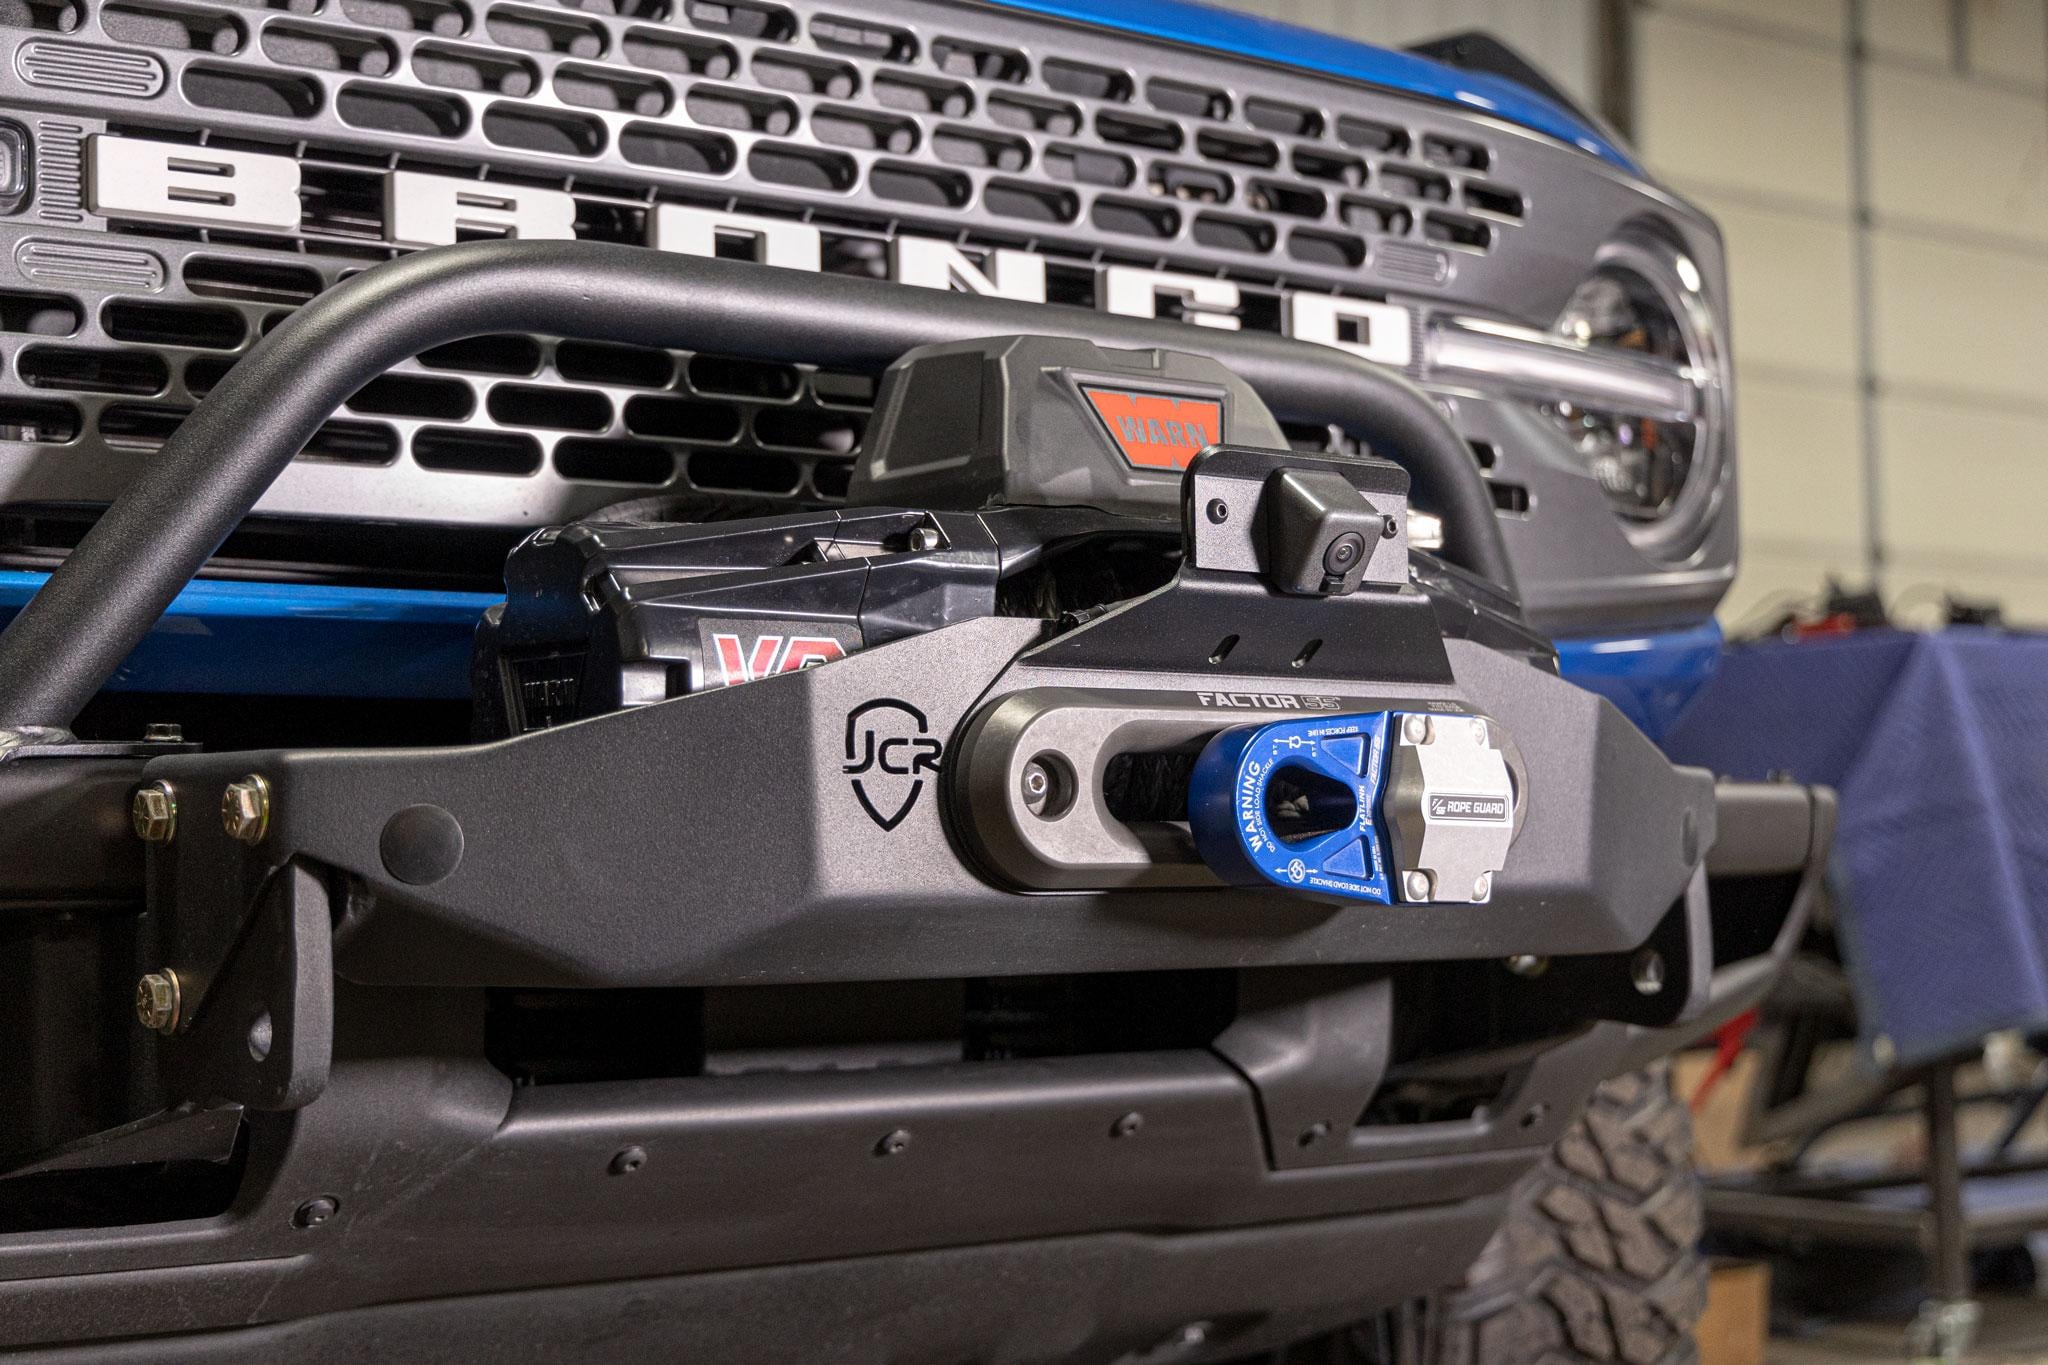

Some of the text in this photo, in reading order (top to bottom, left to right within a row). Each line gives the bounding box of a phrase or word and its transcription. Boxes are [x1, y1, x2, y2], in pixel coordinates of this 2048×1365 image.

[88, 133, 1411, 366] BRONCO
[1116, 415, 1209, 449] WARN
[1196, 691, 1341, 710] FACTOR 55
[842, 730, 943, 775] JCR
[1256, 758, 1274, 786] SHACKLE
[1241, 760, 1262, 853] WARNING
[1358, 784, 1366, 832] FLATLINK
[1447, 801, 1472, 813] ROPE
[1473, 802, 1504, 814] GUARD
[1255, 811, 1263, 826] SIDE
[1257, 827, 1268, 842] NOT
[1266, 841, 1276, 853] DO
[1333, 881, 1349, 890] LOAD
